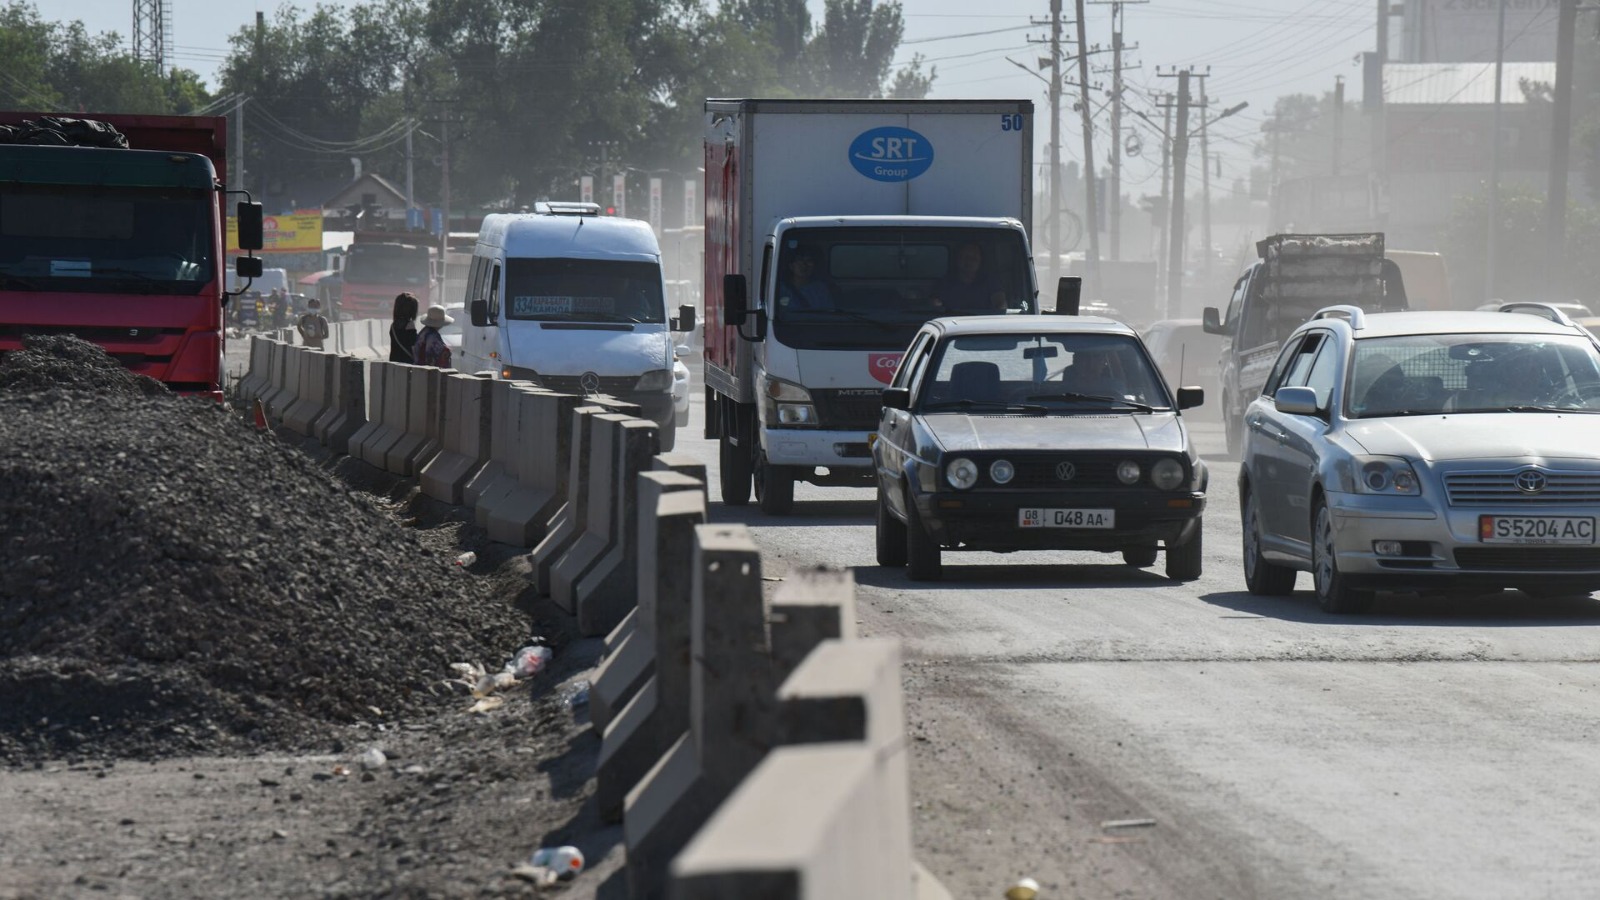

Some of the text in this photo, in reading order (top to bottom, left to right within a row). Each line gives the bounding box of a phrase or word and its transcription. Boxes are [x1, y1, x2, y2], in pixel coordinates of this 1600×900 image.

[1001, 114, 1023, 131] 50
[871, 137, 917, 159] SRT
[874, 165, 908, 178] Group
[515, 297, 532, 312] 334
[1025, 510, 1038, 520] 08
[1054, 511, 1104, 526] 048 AA
